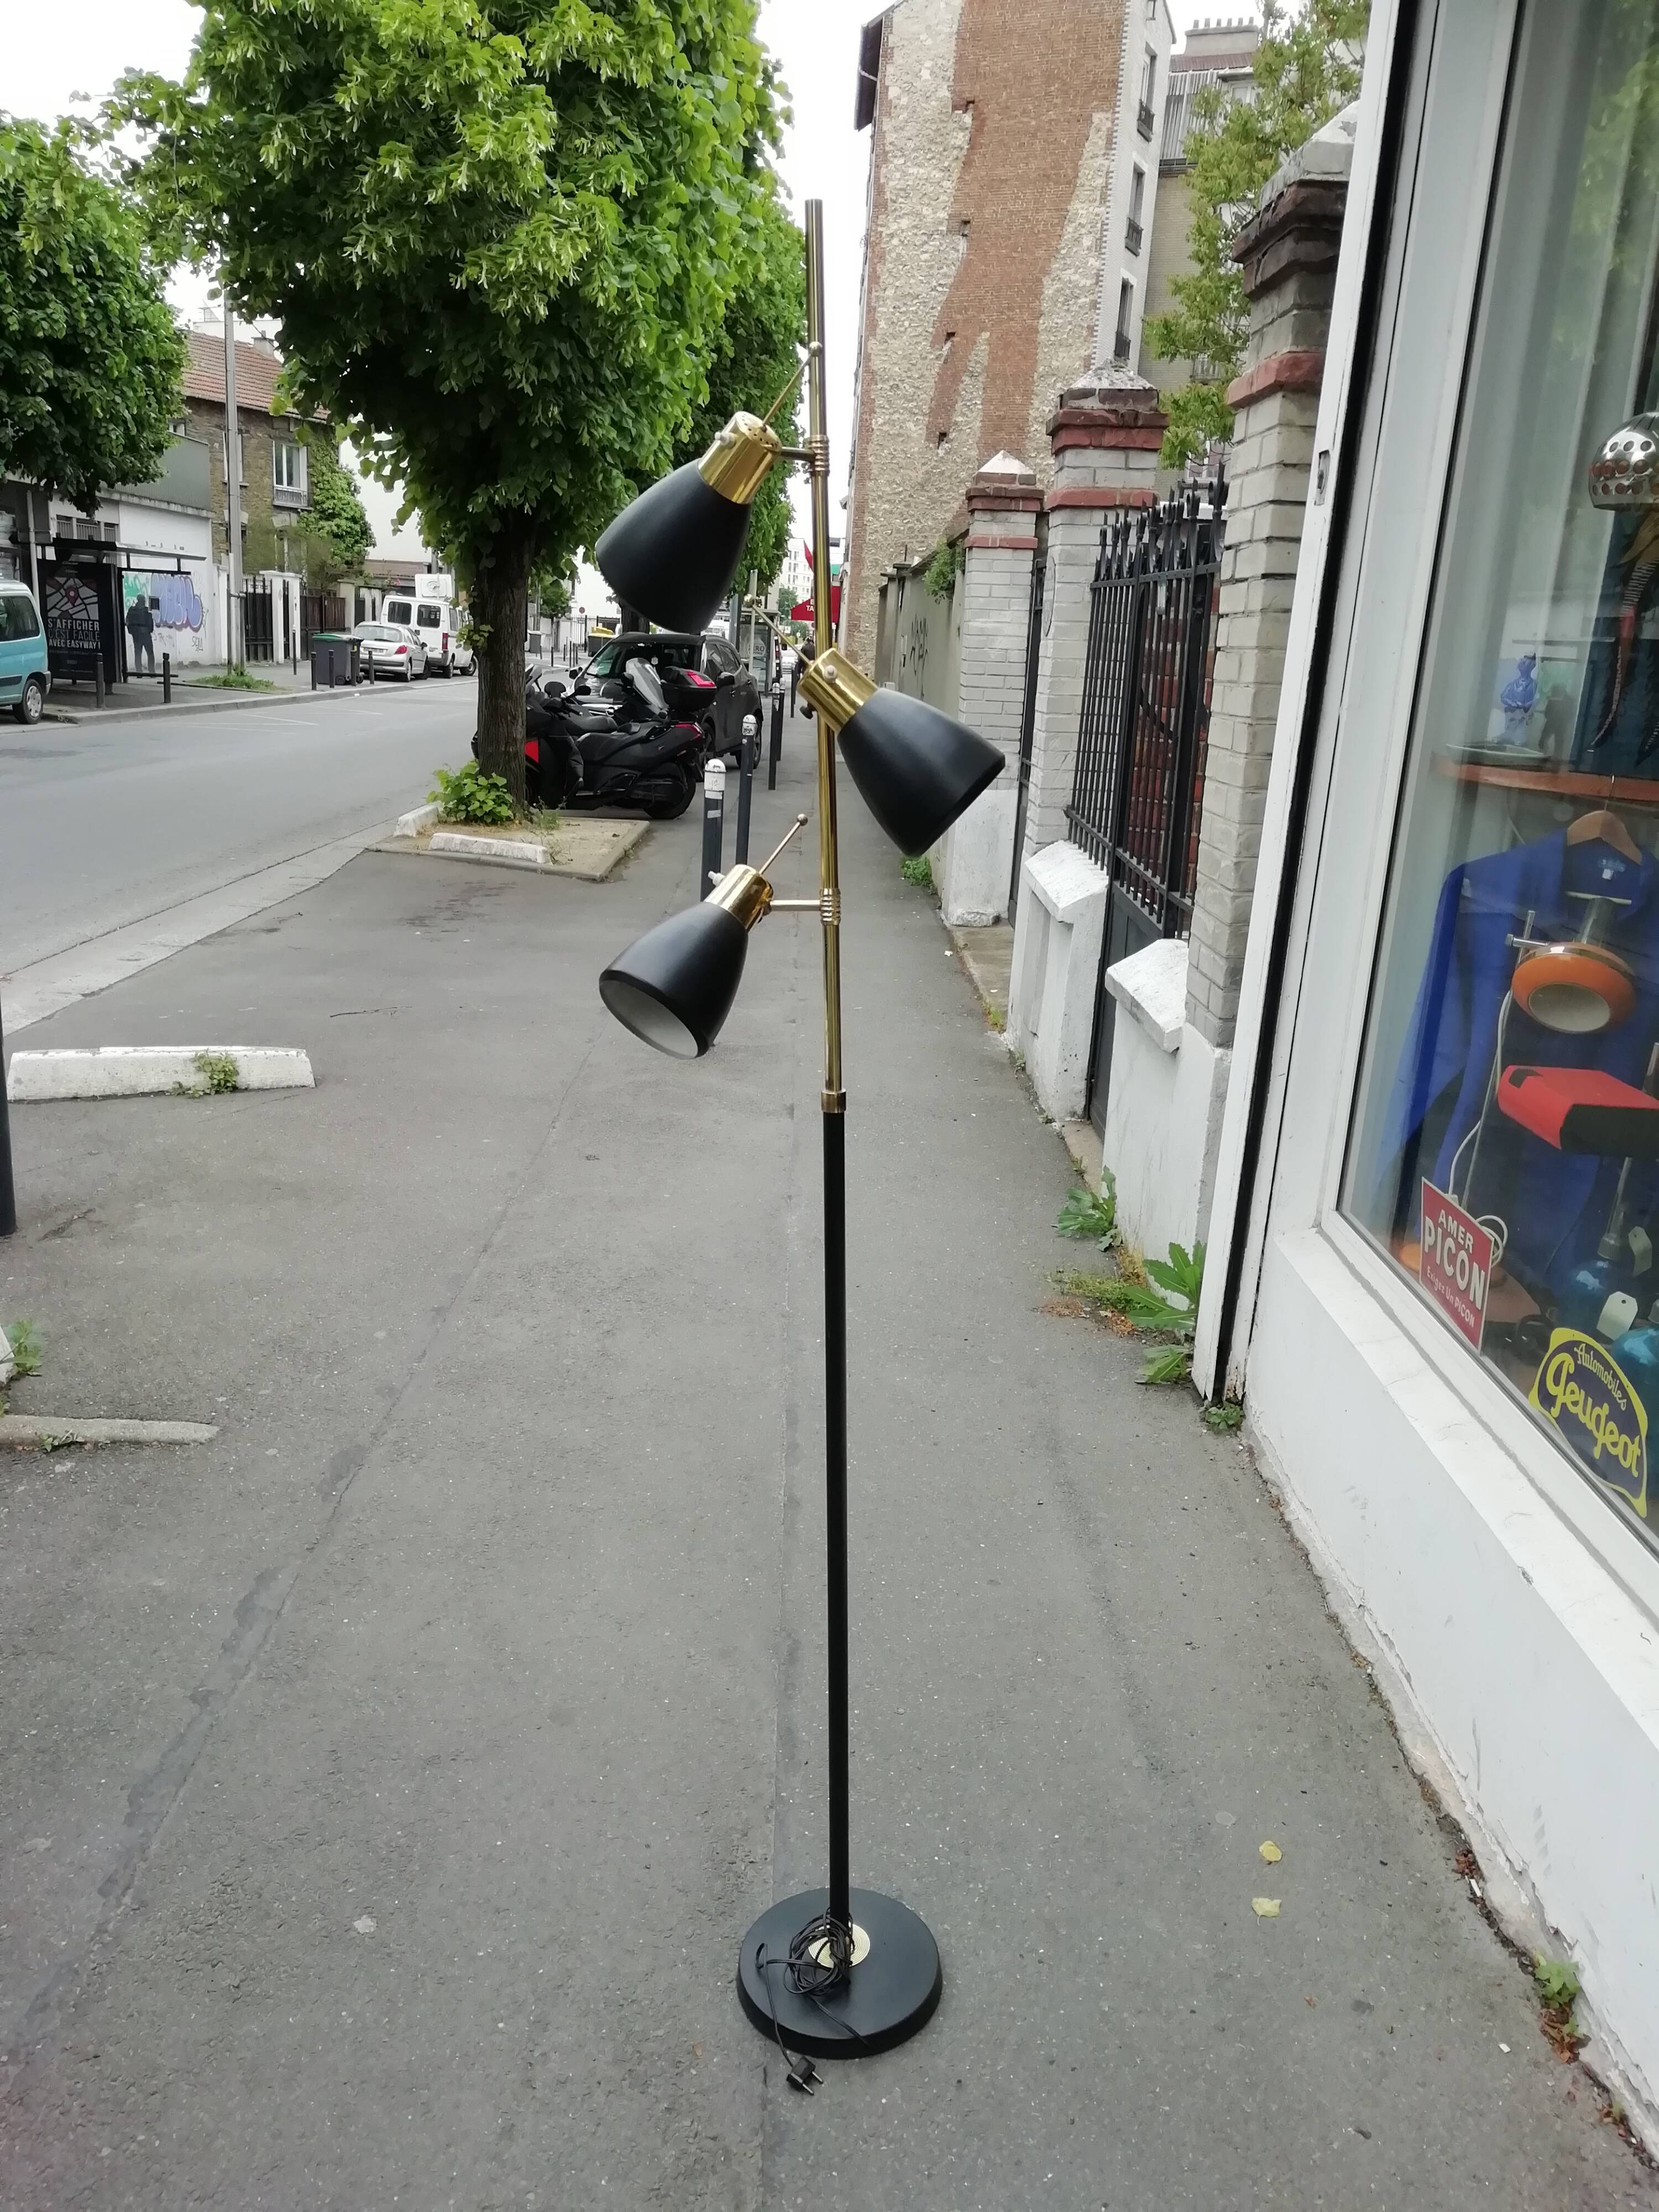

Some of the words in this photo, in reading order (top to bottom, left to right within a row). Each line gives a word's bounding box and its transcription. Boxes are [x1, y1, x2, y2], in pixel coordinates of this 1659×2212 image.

[48, 618, 100, 631] S'AFFICHER
[48, 628, 69, 639] C'EST
[73, 630, 100, 641] FACILE
[49, 639, 65, 648] AVEC
[67, 640, 97, 650] EASYWAY
[1438, 1209, 1474, 1254] AMER
[1424, 1215, 1485, 1310] PICON
[1427, 1265, 1445, 1294] Exigez
[1446, 1286, 1454, 1305] Un
[1454, 1297, 1475, 1328] PICON
[1574, 1343, 1627, 1411] Automobiles
[1546, 1352, 1641, 1477] Peugeot
